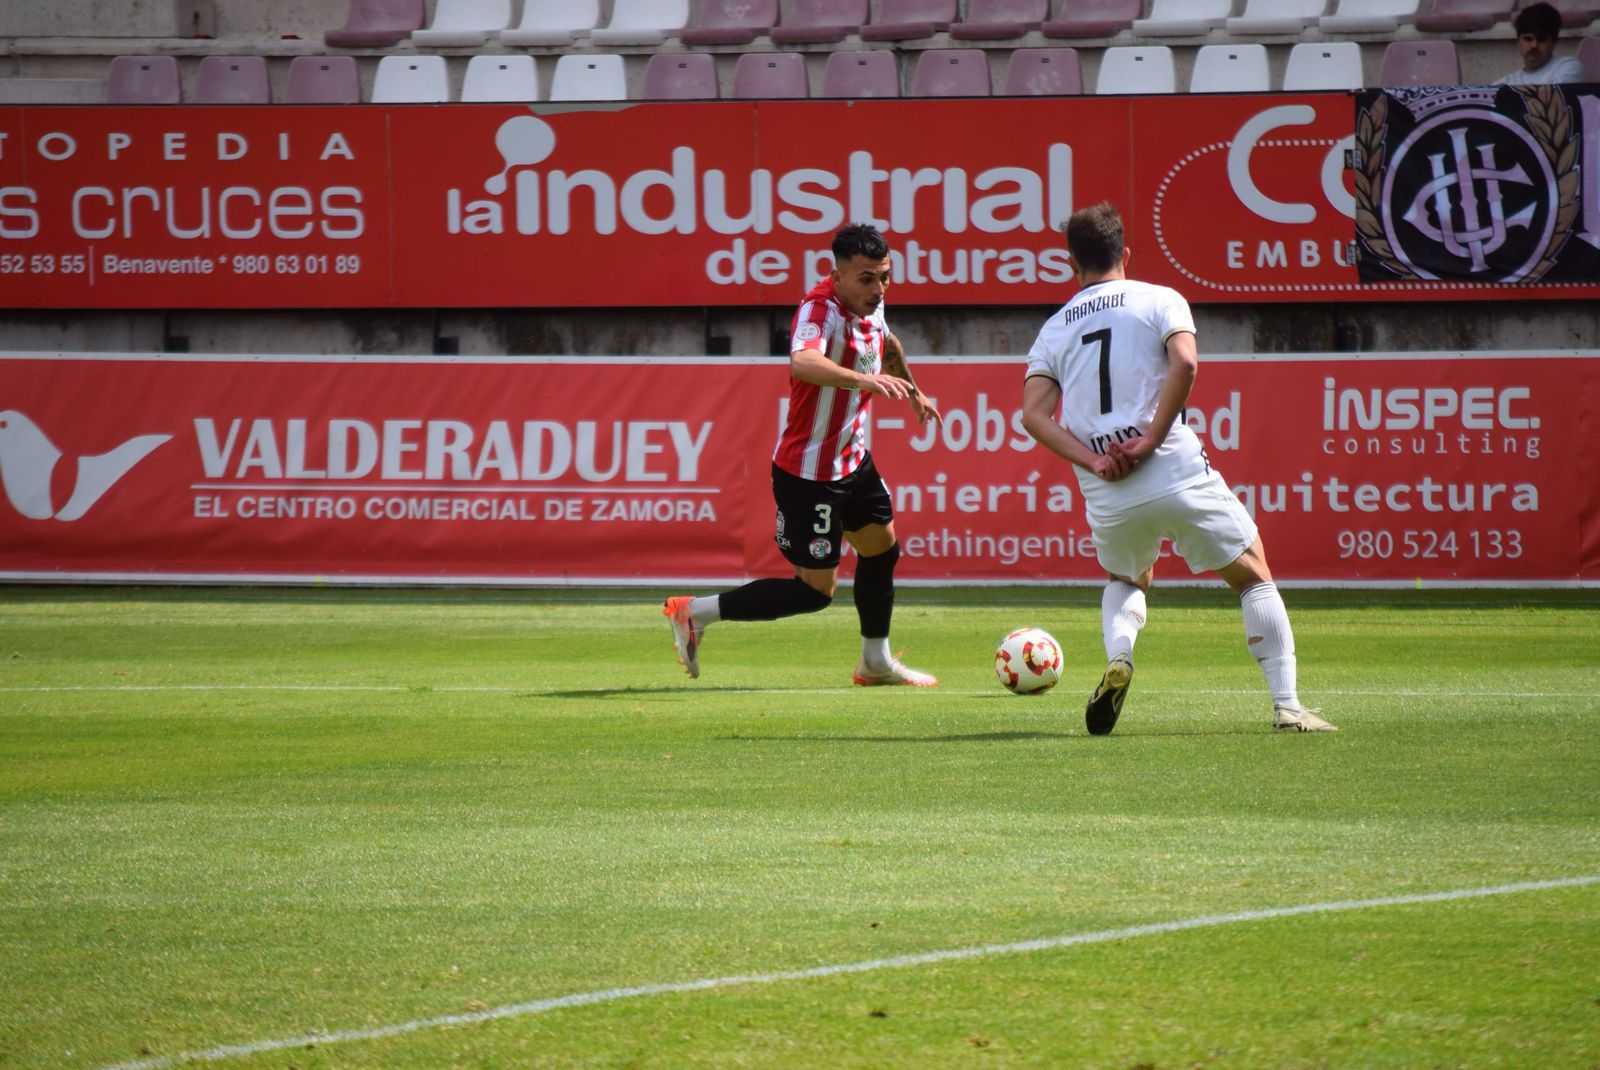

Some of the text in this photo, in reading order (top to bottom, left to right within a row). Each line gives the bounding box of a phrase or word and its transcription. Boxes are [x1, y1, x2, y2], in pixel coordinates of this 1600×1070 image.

[447, 142, 1073, 235] la industrial
[72, 186, 364, 239] cruces
[1, 255, 85, 274] 52 53 55
[103, 255, 360, 274] Benavente 980 63 01 89
[706, 238, 1074, 294] de pnturas
[1065, 292, 1126, 326] ARANZABE
[1081, 327, 1113, 415] 7
[193, 417, 713, 483] VALDERADUEY
[1323, 432, 1541, 458] consulting
[193, 496, 717, 522] EL CENTRO COMERCIAL DE ZAMORA
[813, 503, 832, 534] 3
[1337, 530, 1523, 559] 980 524 133
